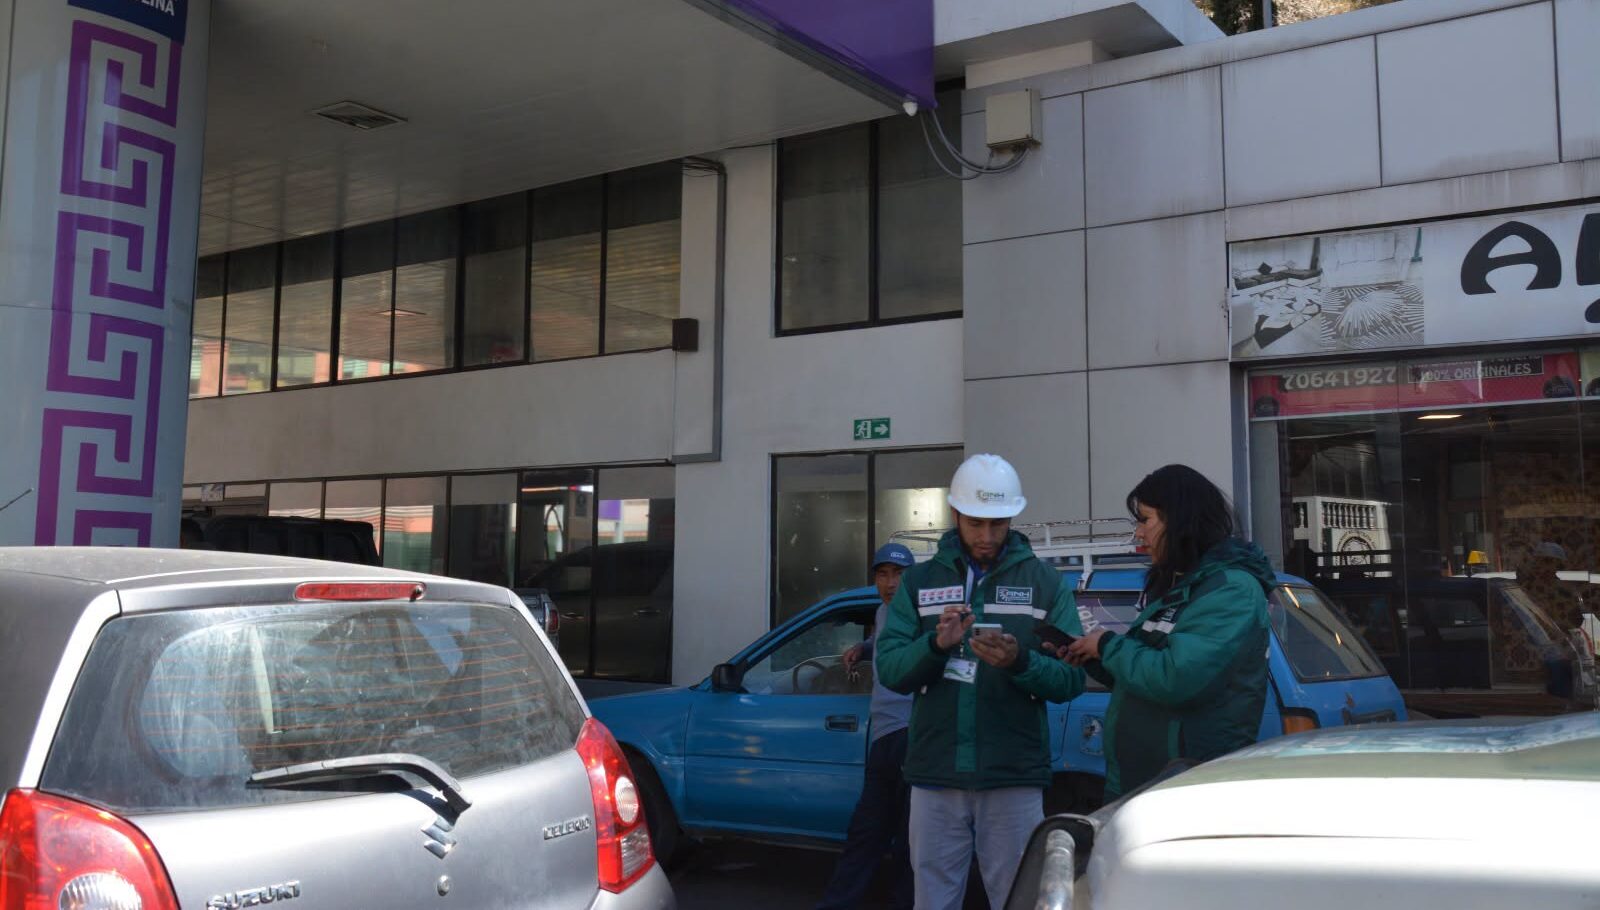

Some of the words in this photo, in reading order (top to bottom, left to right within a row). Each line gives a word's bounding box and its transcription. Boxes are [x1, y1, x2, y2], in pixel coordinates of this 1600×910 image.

[1283, 366, 1397, 390] 70641927
[1455, 363, 1532, 379] ORIGINALES
[206, 880, 300, 910] SUZUKI
